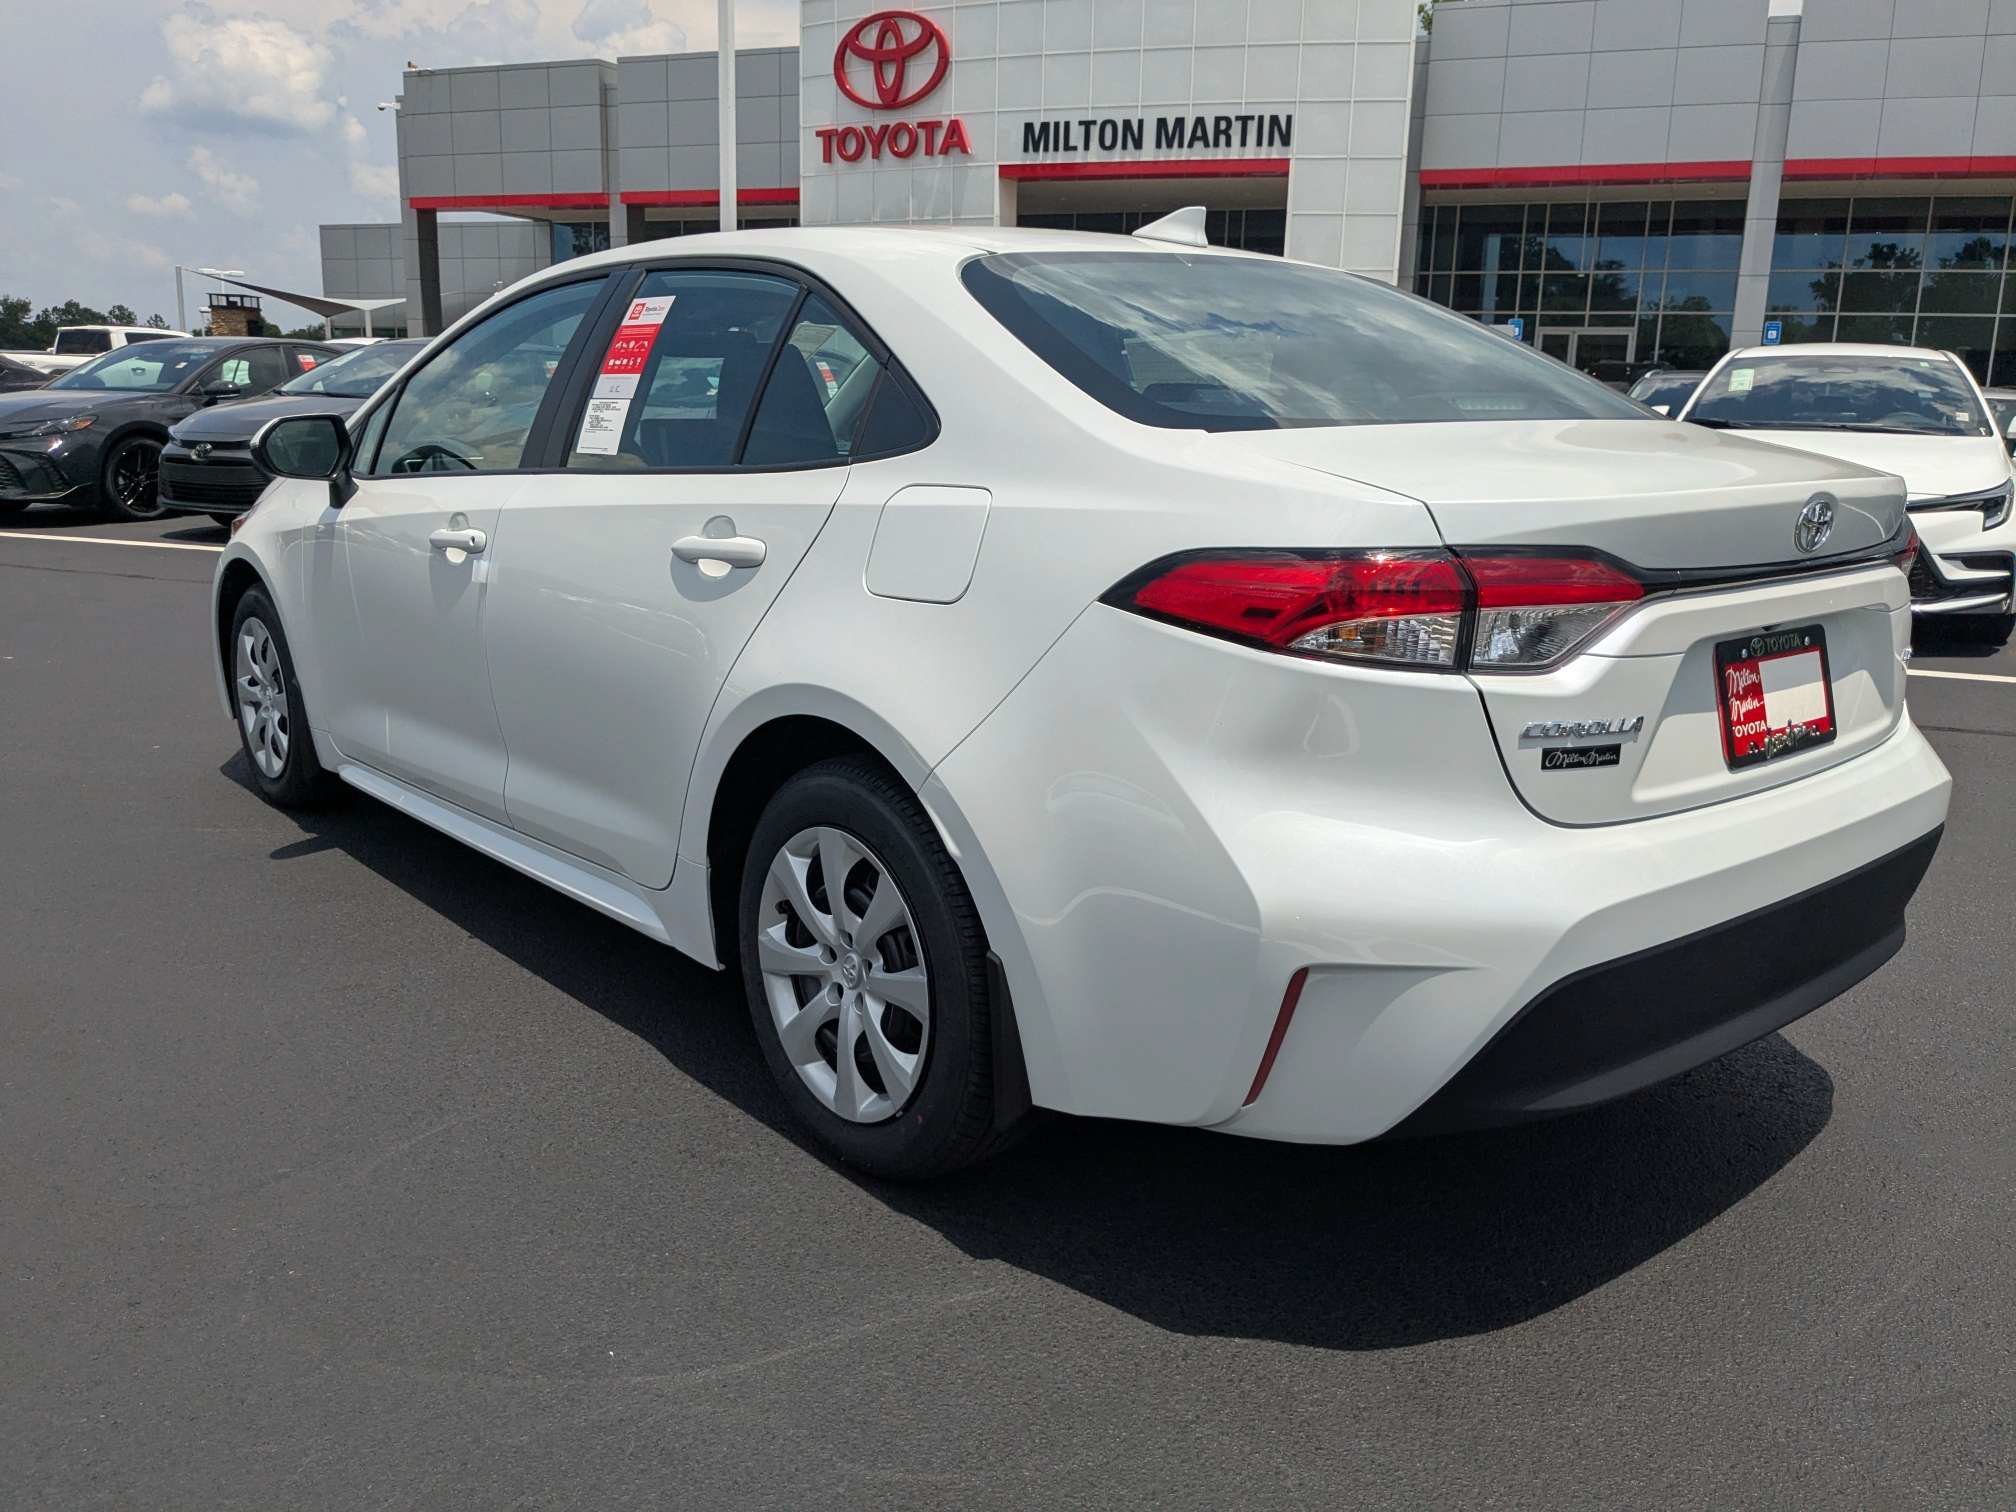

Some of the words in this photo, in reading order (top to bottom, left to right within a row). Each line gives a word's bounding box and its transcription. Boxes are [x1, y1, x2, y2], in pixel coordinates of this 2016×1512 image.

[815, 118, 973, 163] TOYOTA
[1022, 118, 1144, 153] MILTON
[1155, 114, 1293, 149] MARTIN
[1766, 632, 1801, 651] TOYOTA
[1725, 667, 1760, 697] Milton
[1729, 693, 1764, 722] Martin
[1519, 715, 1644, 738] COROLLA
[1732, 720, 1767, 738] OYOTA
[1545, 750, 1586, 767] Milton
